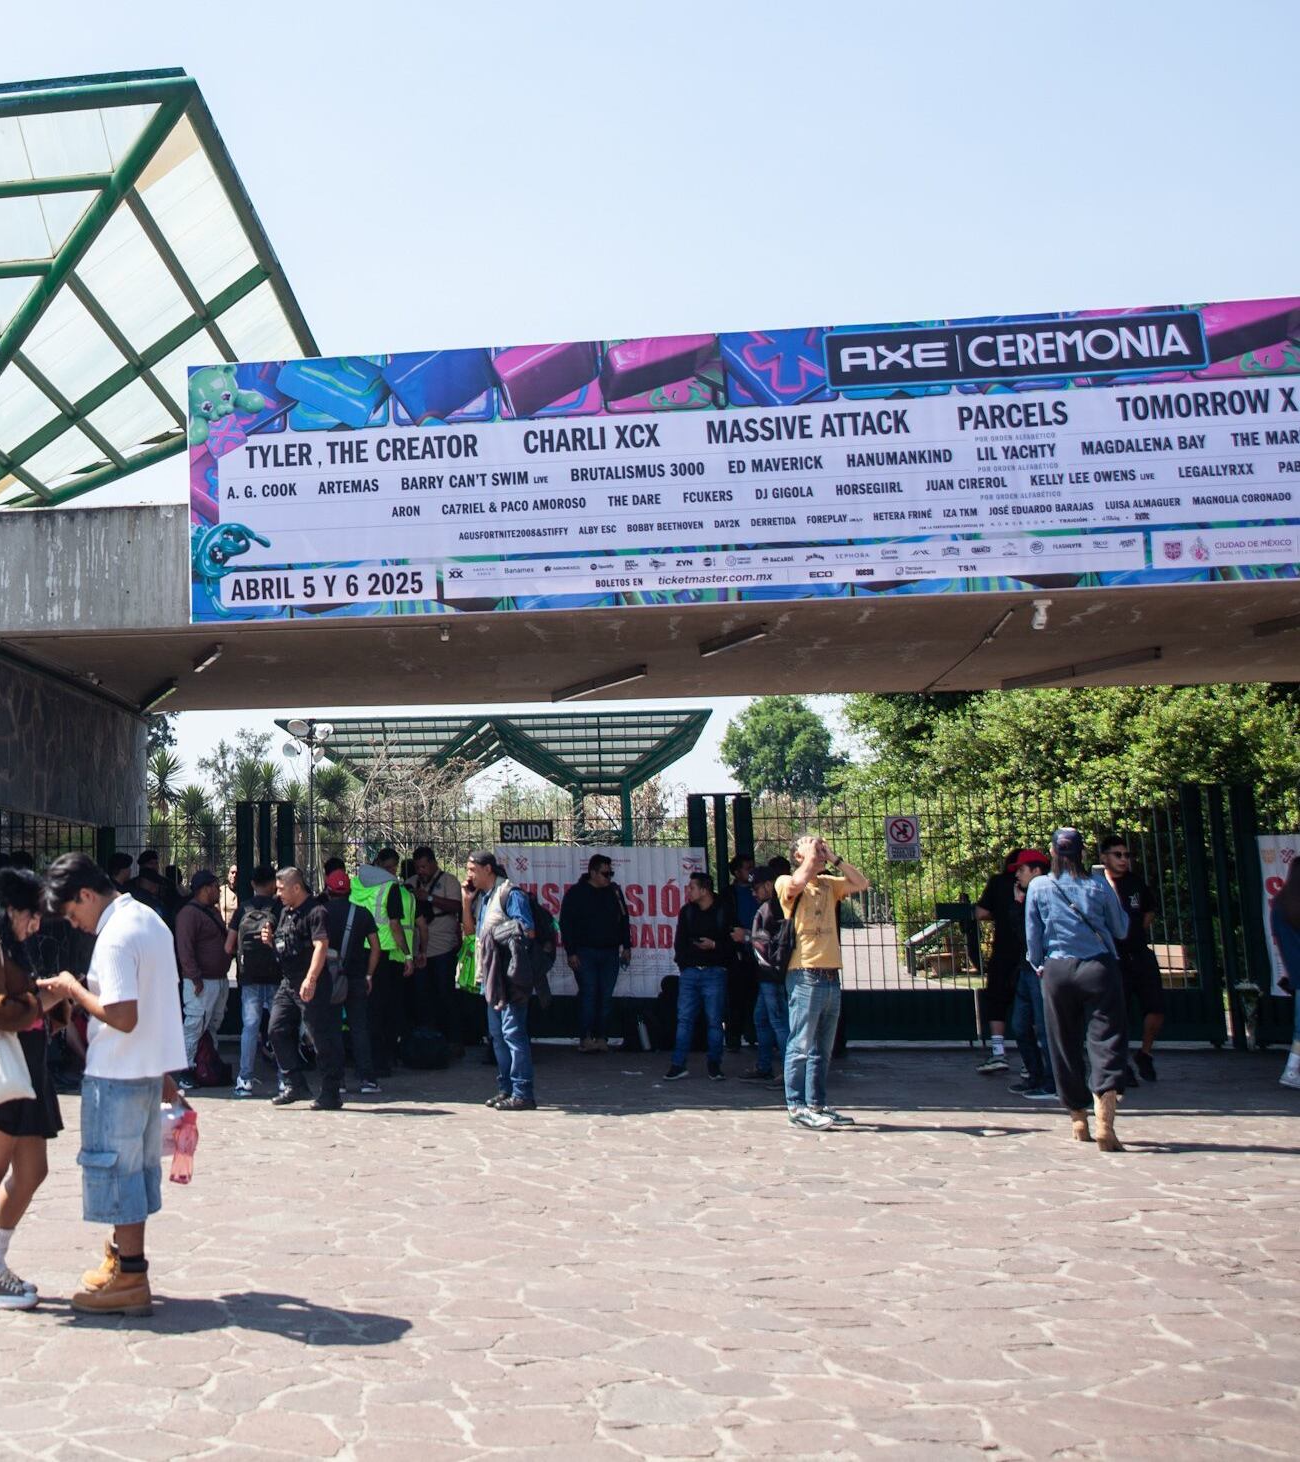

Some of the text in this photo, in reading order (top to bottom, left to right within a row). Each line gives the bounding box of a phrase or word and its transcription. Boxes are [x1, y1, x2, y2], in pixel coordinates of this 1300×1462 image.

[840, 323, 1191, 373] AXE CEREMONIA
[327, 440, 369, 464] THE
[376, 433, 479, 462] CREATOR
[523, 426, 607, 455] CHARLI
[615, 423, 661, 450] XCX
[706, 414, 813, 444] MASSIVE
[820, 409, 910, 438] ATTACK
[957, 400, 1069, 431] PARCELS
[1116, 388, 1270, 422] TOMORROW
[1279, 386, 1299, 412] X
[227, 486, 240, 499] A.
[244, 485, 257, 498] G.
[262, 483, 297, 498] COOK
[318, 478, 379, 495] ARTEMAS
[401, 475, 444, 491] BARRY
[491, 471, 529, 486] SWIM
[533, 475, 549, 484] LIVE
[571, 463, 665, 482] BRUTALISMUS
[670, 461, 705, 476] 3000
[728, 460, 746, 474] ED
[751, 455, 823, 473] MAVERICK
[846, 448, 953, 468] HANUMANKIND
[976, 447, 998, 461] LIL
[1001, 443, 1056, 460] YACHTY
[1081, 437, 1173, 456] MAGDALENA
[1177, 434, 1206, 450] BAY
[1230, 432, 1260, 447] THE
[1265, 428, 1300, 445] MAR
[392, 506, 420, 517] ARON
[442, 501, 488, 515] CA7RIEL
[489, 501, 497, 513] &
[501, 499, 529, 512] PACO
[532, 497, 586, 510] AMOROSO
[608, 495, 628, 507] THE
[632, 493, 661, 506] DARE
[683, 490, 733, 503] FCUKERS
[755, 488, 768, 500] DJ
[772, 486, 813, 499] GIGOLA
[836, 482, 903, 496] HORSEGIIRL
[925, 479, 954, 492] JUAN
[958, 476, 1008, 490] CIREROL
[1030, 473, 1064, 486] KELLY
[1069, 472, 1090, 484] LEE
[1094, 469, 1136, 482] OWENS
[1178, 463, 1254, 478] LEGALLYRXX
[1278, 461, 1300, 473] PAB
[459, 526, 568, 541] AGUSFORTNITE2008&STIFFY
[578, 525, 598, 536] ALBY
[601, 525, 617, 534] ESC
[627, 523, 654, 533] BOBBY
[656, 520, 704, 532] BEETHOVEN
[714, 519, 740, 529] DAY2K
[750, 516, 796, 527] DERRETIDA
[806, 514, 848, 525] FOREPLAY
[873, 511, 905, 521] HETERA
[908, 508, 932, 520] FRINÉ
[943, 508, 957, 518] IZA
[959, 507, 978, 517] TKM
[989, 505, 1009, 516] JOSÉ
[1011, 504, 1052, 514] EDUARDO
[1055, 502, 1093, 512] BARAJAS
[1105, 500, 1130, 510] LUISA
[1132, 497, 1181, 509] ALMAGUER
[1192, 494, 1239, 505] MAGNOLIA
[1241, 492, 1292, 503] CORONADO
[676, 559, 693, 567] ZYN
[1214, 541, 1245, 549] CIUDAD
[1260, 538, 1292, 547] MÉXICO
[231, 571, 424, 601] ABRIL 5 Y 6 2025
[595, 572, 773, 588] BOLETOS EN ticketmaster.com.mx
[503, 824, 550, 840] SALIDA
